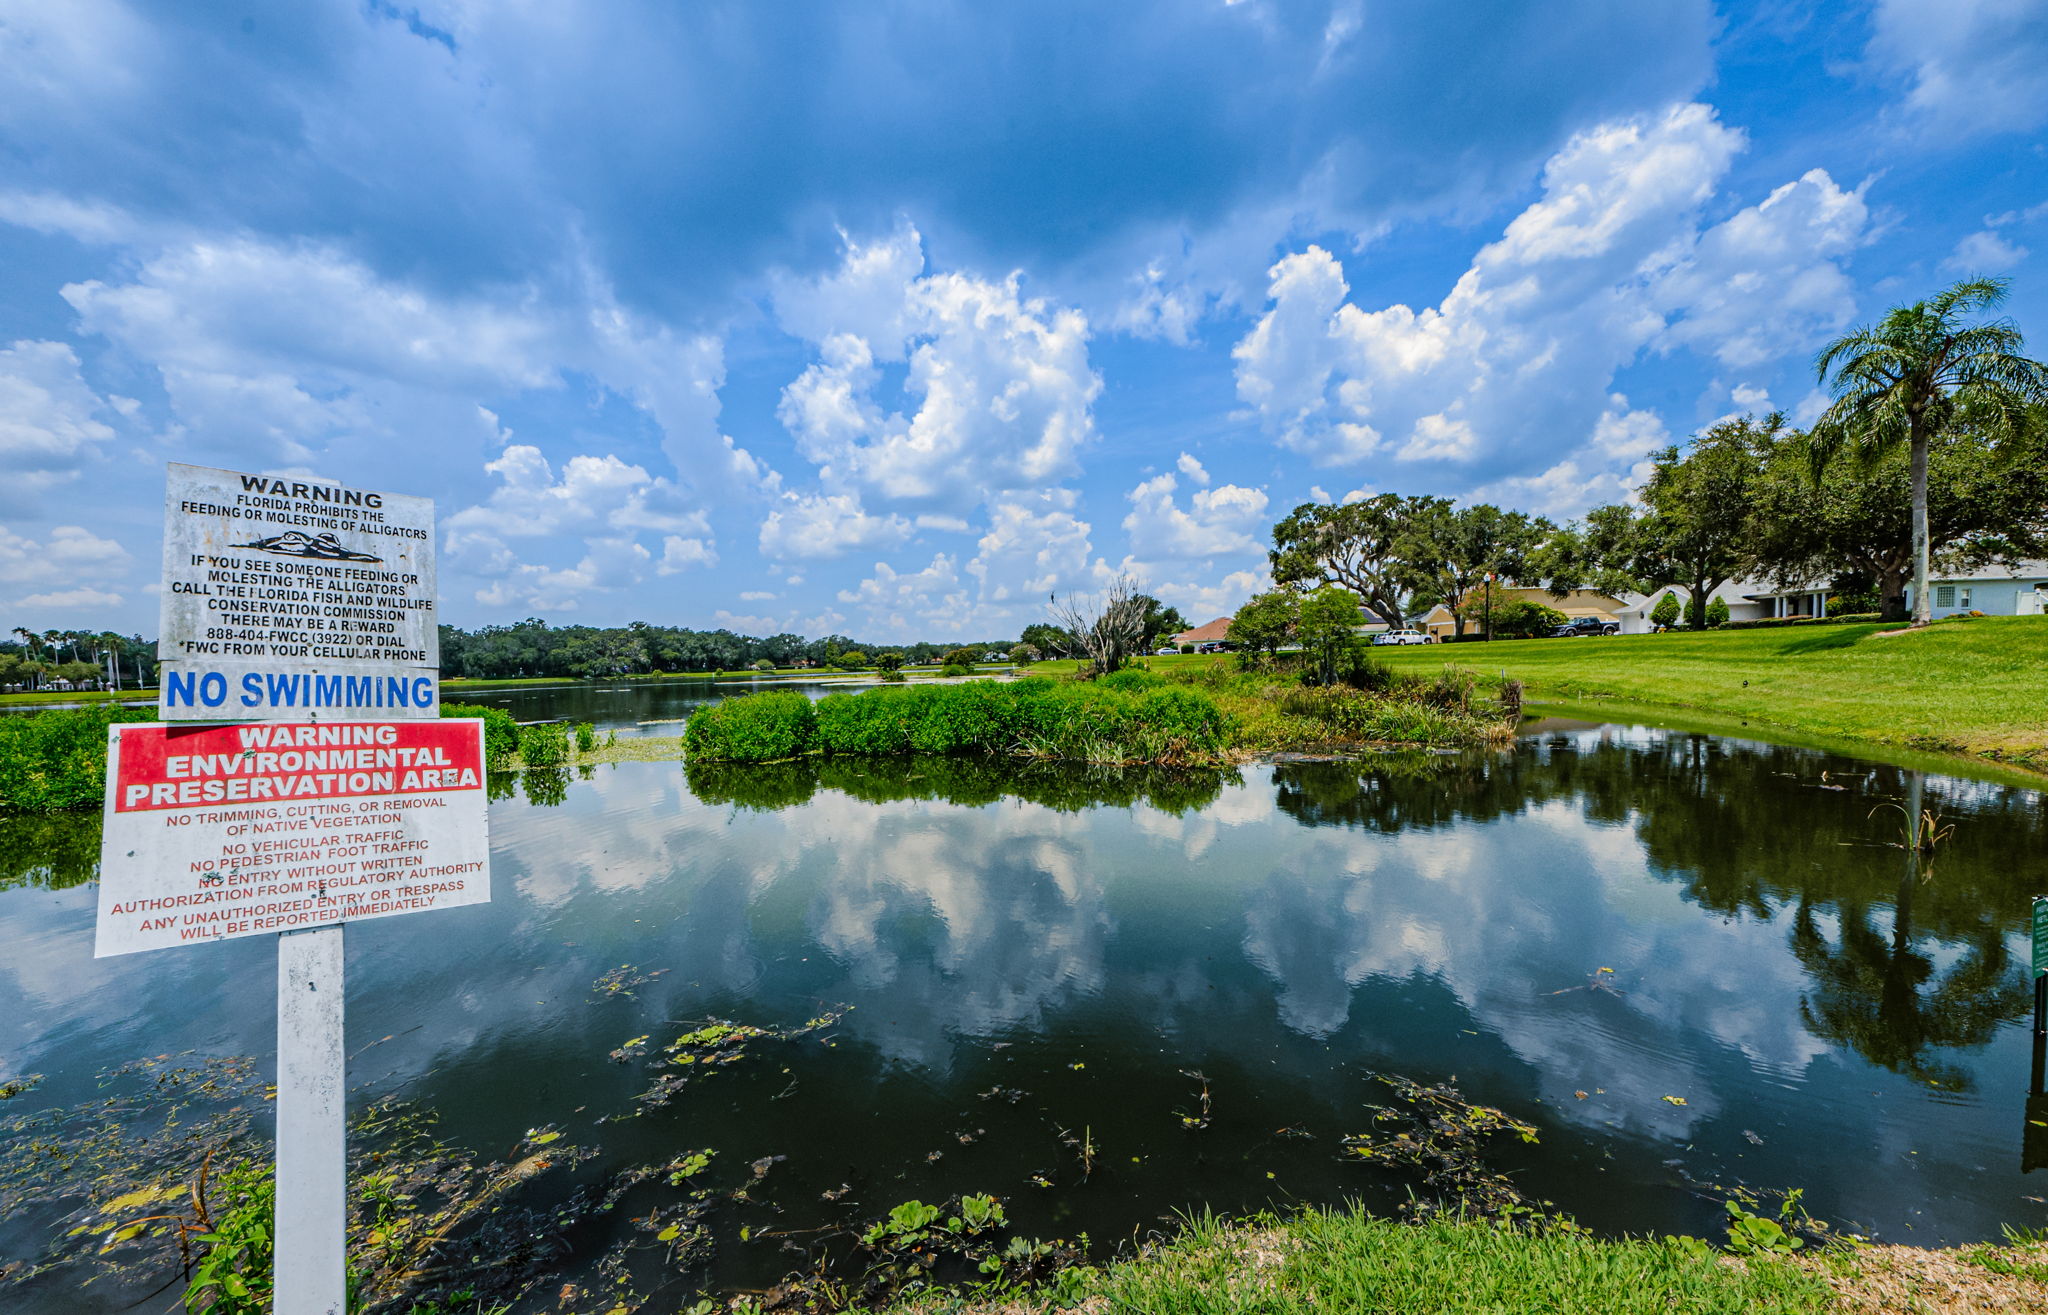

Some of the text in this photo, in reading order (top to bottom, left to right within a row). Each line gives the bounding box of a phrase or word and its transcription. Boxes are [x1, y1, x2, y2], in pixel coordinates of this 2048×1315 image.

[240, 475, 383, 508] WARNING
[181, 501, 427, 540] FEEDING OR MOLESTING OF ALLIGATORS
[237, 495, 384, 522] FLORIDA PROHIBITS THE
[191, 555, 418, 585] IF YOU SEE SOMEONE FEEDING OR
[208, 570, 405, 596] MOLESTING THE ALLIGATORS
[172, 582, 432, 610] CALL THE FLORIDA FISH AND WILDLIFE
[208, 599, 405, 621] CONSERVATION COMMISSION
[207, 628, 405, 647] 888-404-FWCC (3922) OR DIAL
[221, 614, 270, 627] THERE
[274, 617, 304, 629] MAY
[307, 618, 324, 630] BE
[328, 620, 338, 631] A
[224, 643, 265, 655] FROM
[270, 644, 308, 657] YOUR
[313, 646, 380, 659] CELLULAR
[384, 648, 426, 661] PHONE
[167, 671, 433, 709] NO SWIMMING
[239, 726, 397, 748] WARNING
[166, 747, 451, 778] ENVIRONMENTAL
[125, 768, 478, 807] PRESERVATION AREA
[166, 797, 446, 827] NO TRIMMING, CUTTING, OR REMOVAL
[227, 813, 402, 837] OF NATIVE VEGETATION
[191, 839, 429, 873] NO PEDESTRIAN FOOT TRAFFIC
[223, 829, 404, 855] NO VEHICULAR TRAFFIC
[198, 855, 423, 888] NO ENTRY WITHOUT WRITTEN
[111, 861, 484, 916] AUTHORIZATION FROM REGULATORY AUTHORITY
[139, 880, 465, 932] ANY UNAUTHORIZED ENTRY OR TRESPASS
[180, 895, 436, 940] WILL BE REPORTED IMMEDIATELY
